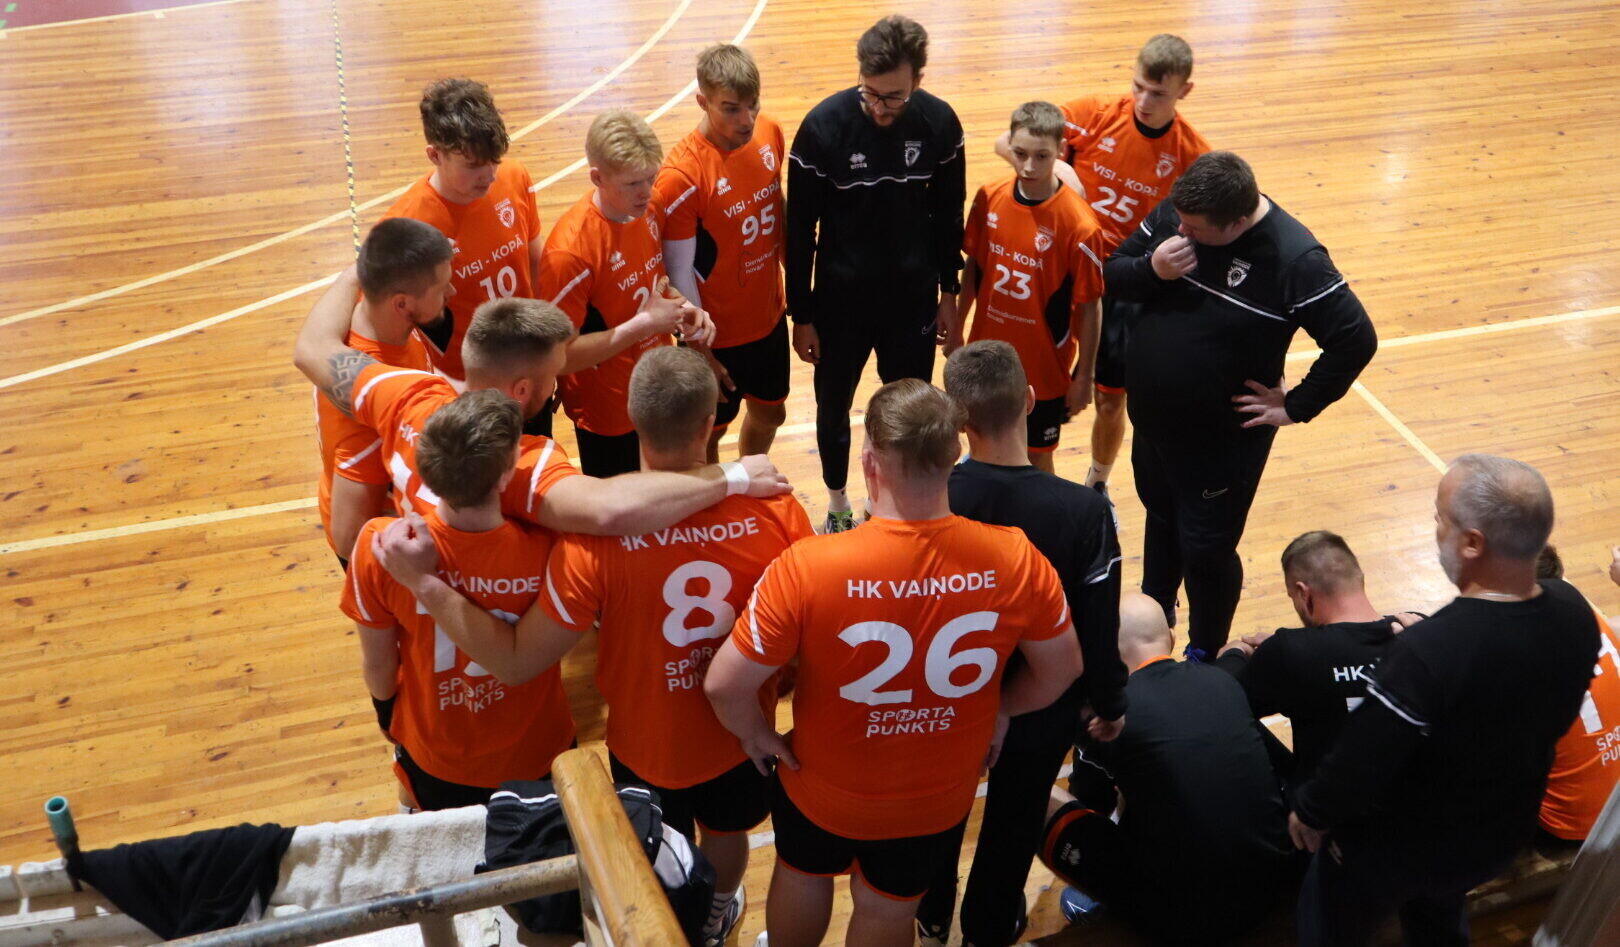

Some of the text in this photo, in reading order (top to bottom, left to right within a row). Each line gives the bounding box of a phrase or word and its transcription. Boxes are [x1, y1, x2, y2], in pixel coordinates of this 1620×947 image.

[1092, 161, 1117, 181] VISI
[723, 200, 745, 218] VISI
[1090, 186, 1139, 223] 25
[741, 203, 775, 246] 95
[455, 260, 484, 279] VISI
[492, 233, 524, 262] KOPĀ
[480, 265, 517, 301] 10
[617, 271, 639, 292] VISI
[633, 273, 659, 314] 2
[994, 263, 1031, 300] 23
[652, 516, 760, 547] VAIŅODE
[847, 570, 996, 600] HK VAIŅODE
[662, 560, 736, 648] 8
[837, 611, 999, 706] 26
[1332, 665, 1365, 682] HK
[866, 718, 951, 738] PUNKTS
[868, 706, 956, 723] SPORTA
